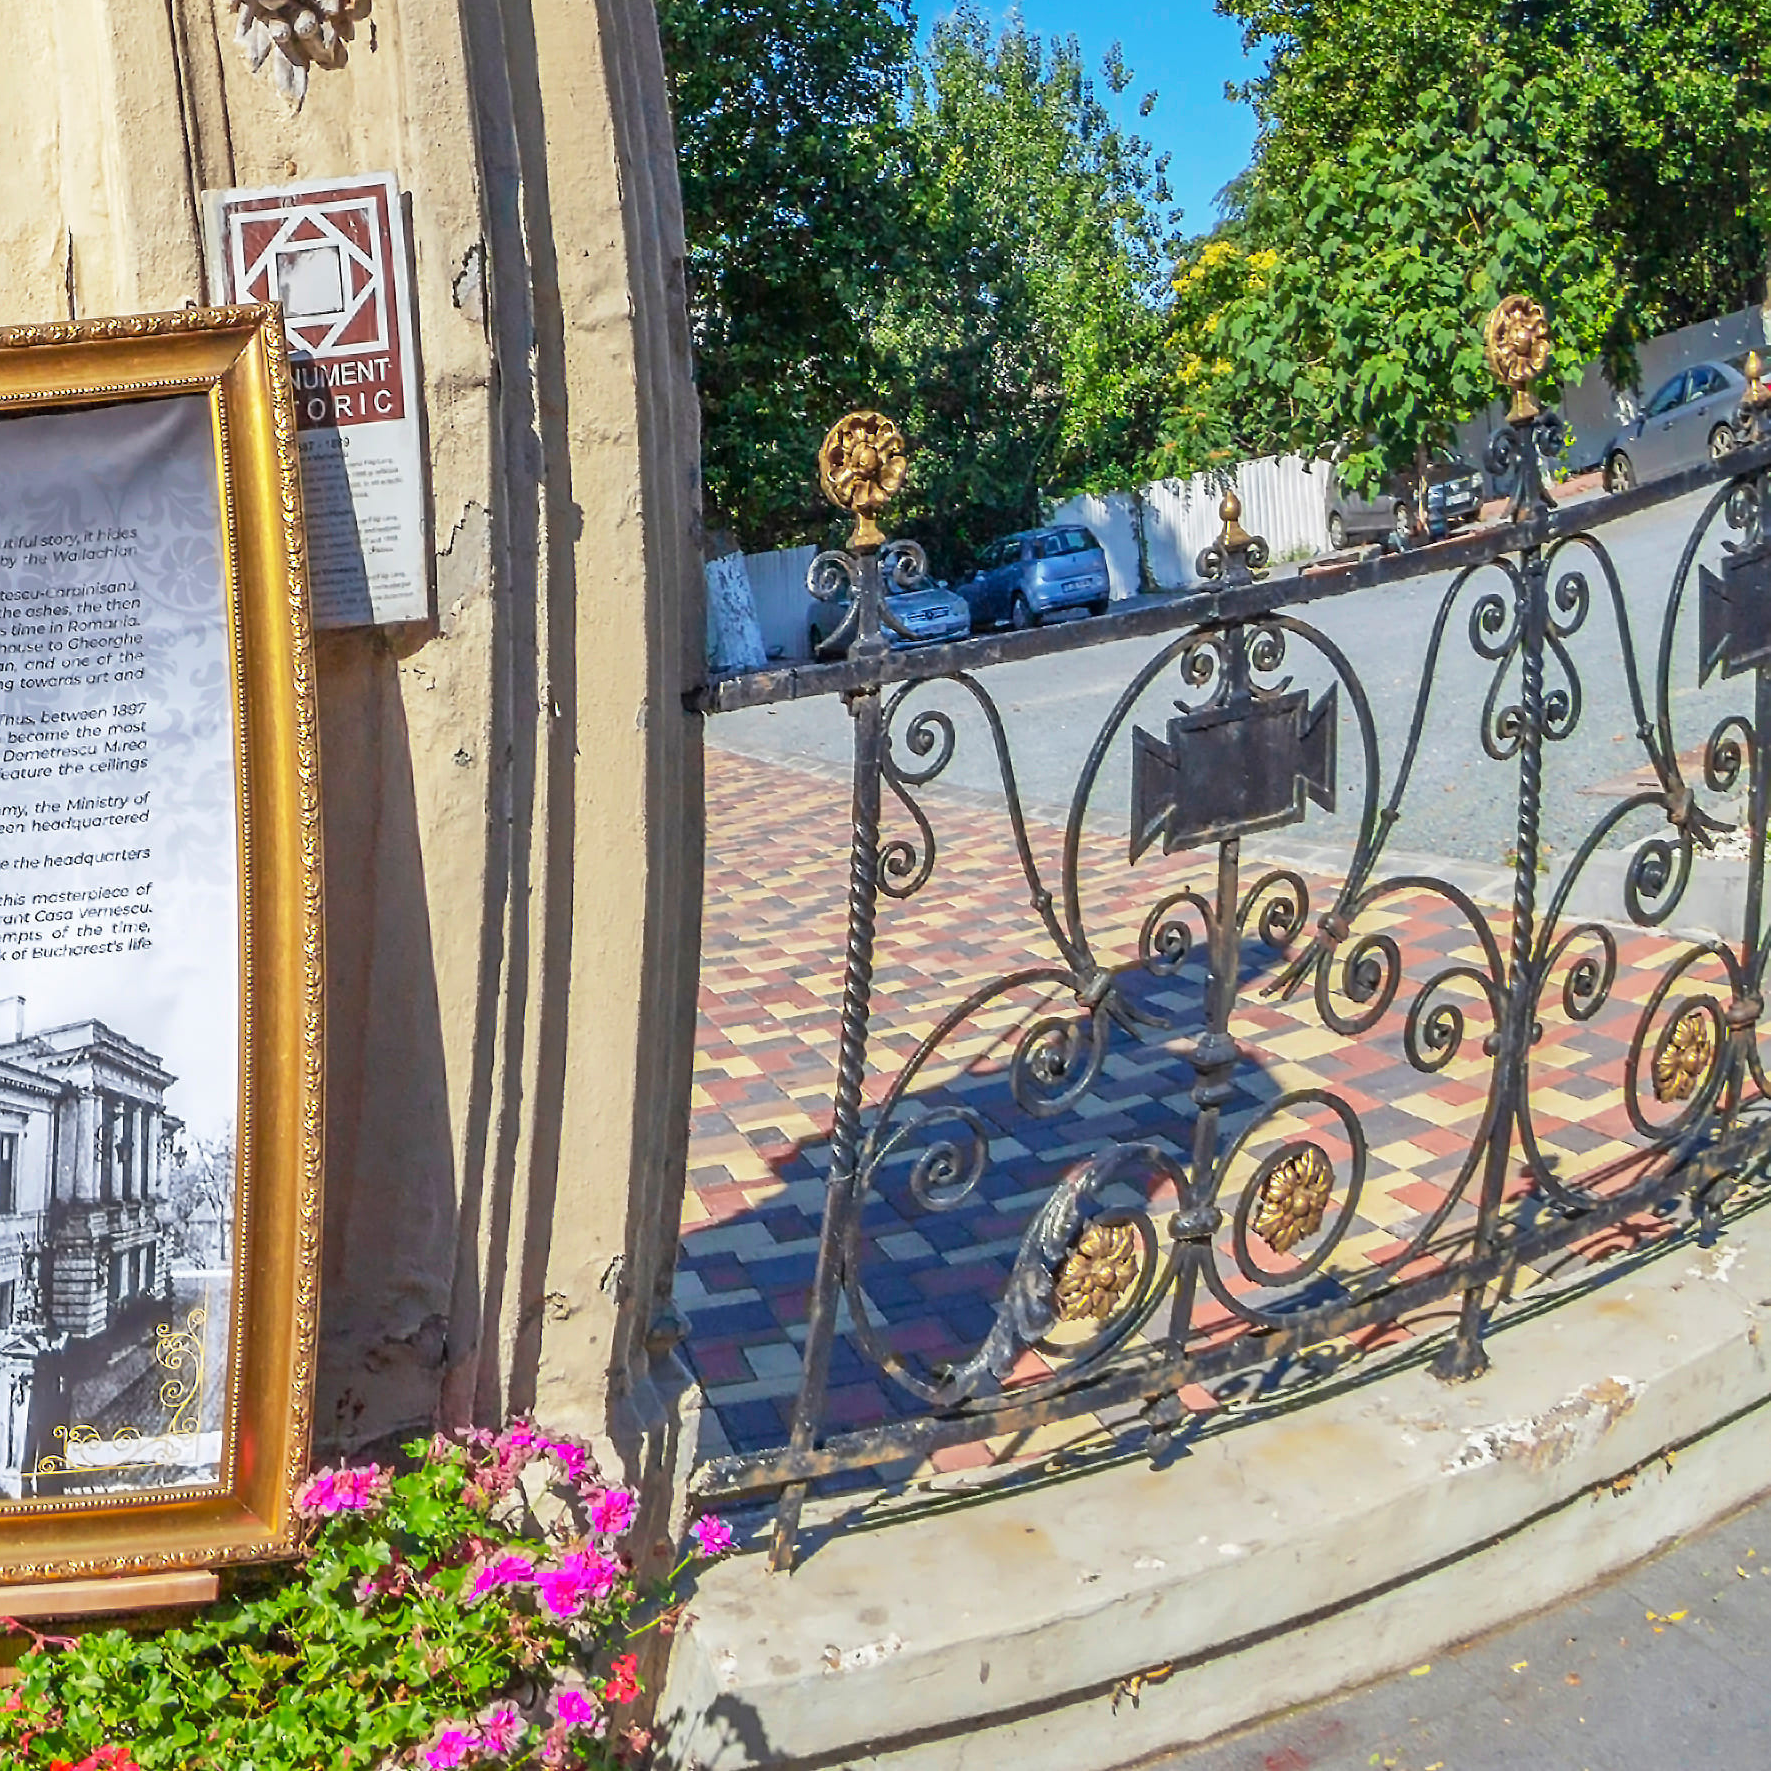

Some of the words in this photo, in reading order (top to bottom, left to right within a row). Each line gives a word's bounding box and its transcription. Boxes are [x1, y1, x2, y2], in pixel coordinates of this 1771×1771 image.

[294, 389, 393, 421] ORIC
[105, 596, 141, 610] then
[10, 623, 45, 636] time
[113, 667, 145, 681] and
[40, 706, 107, 722] between
[107, 721, 146, 735] most
[88, 756, 148, 775] ceilings
[66, 794, 128, 813] Ministry
[33, 907, 74, 922] Casa
[128, 937, 152, 951] life
